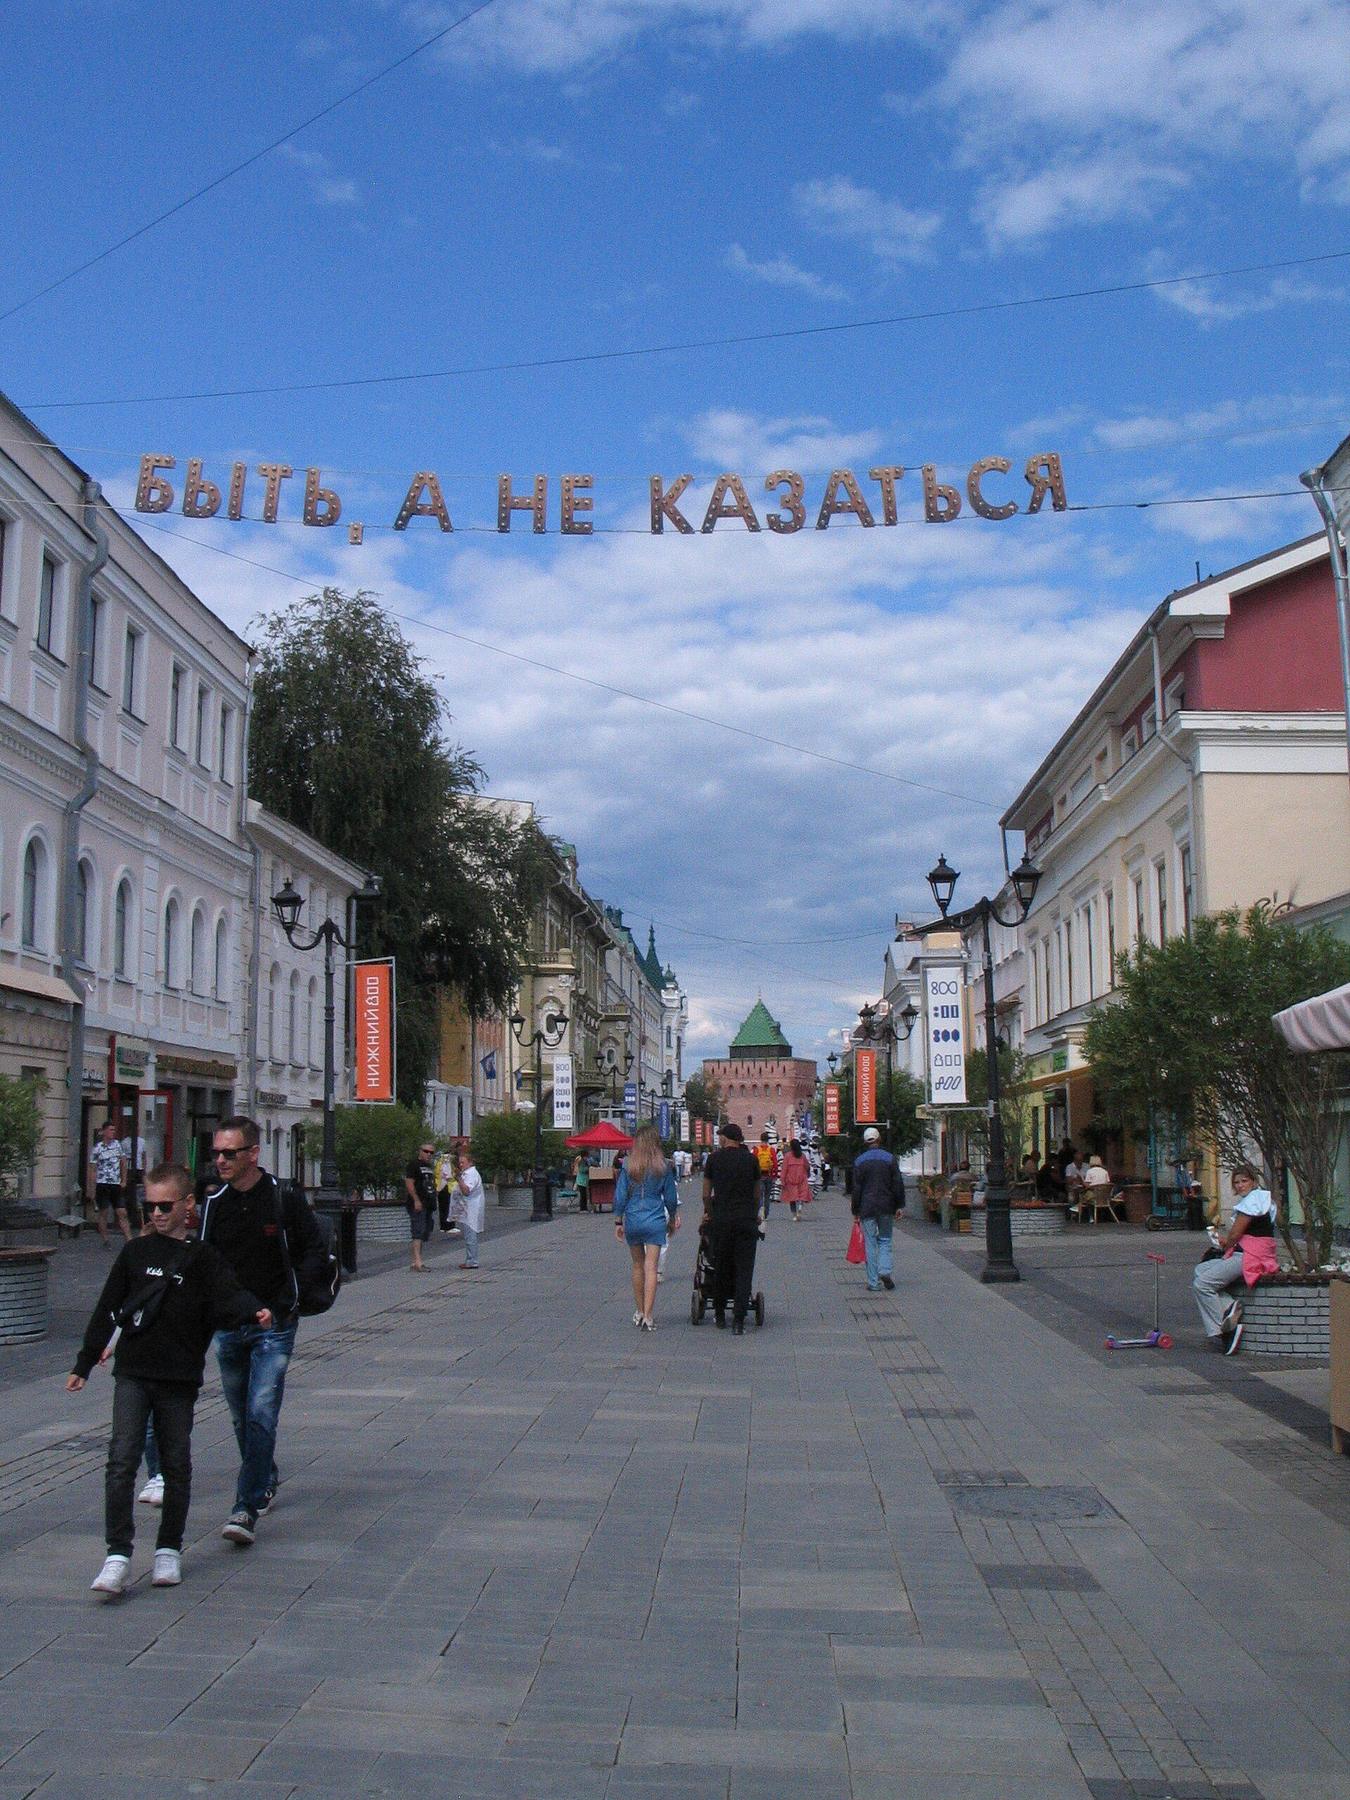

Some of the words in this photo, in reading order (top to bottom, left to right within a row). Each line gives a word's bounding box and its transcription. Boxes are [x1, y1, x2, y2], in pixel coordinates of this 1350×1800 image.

[394, 472, 454, 533] А
[497, 473, 594, 534] НЕ
[649, 451, 1067, 535] КАЗАТЬСЯ
[931, 981, 958, 995] 800
